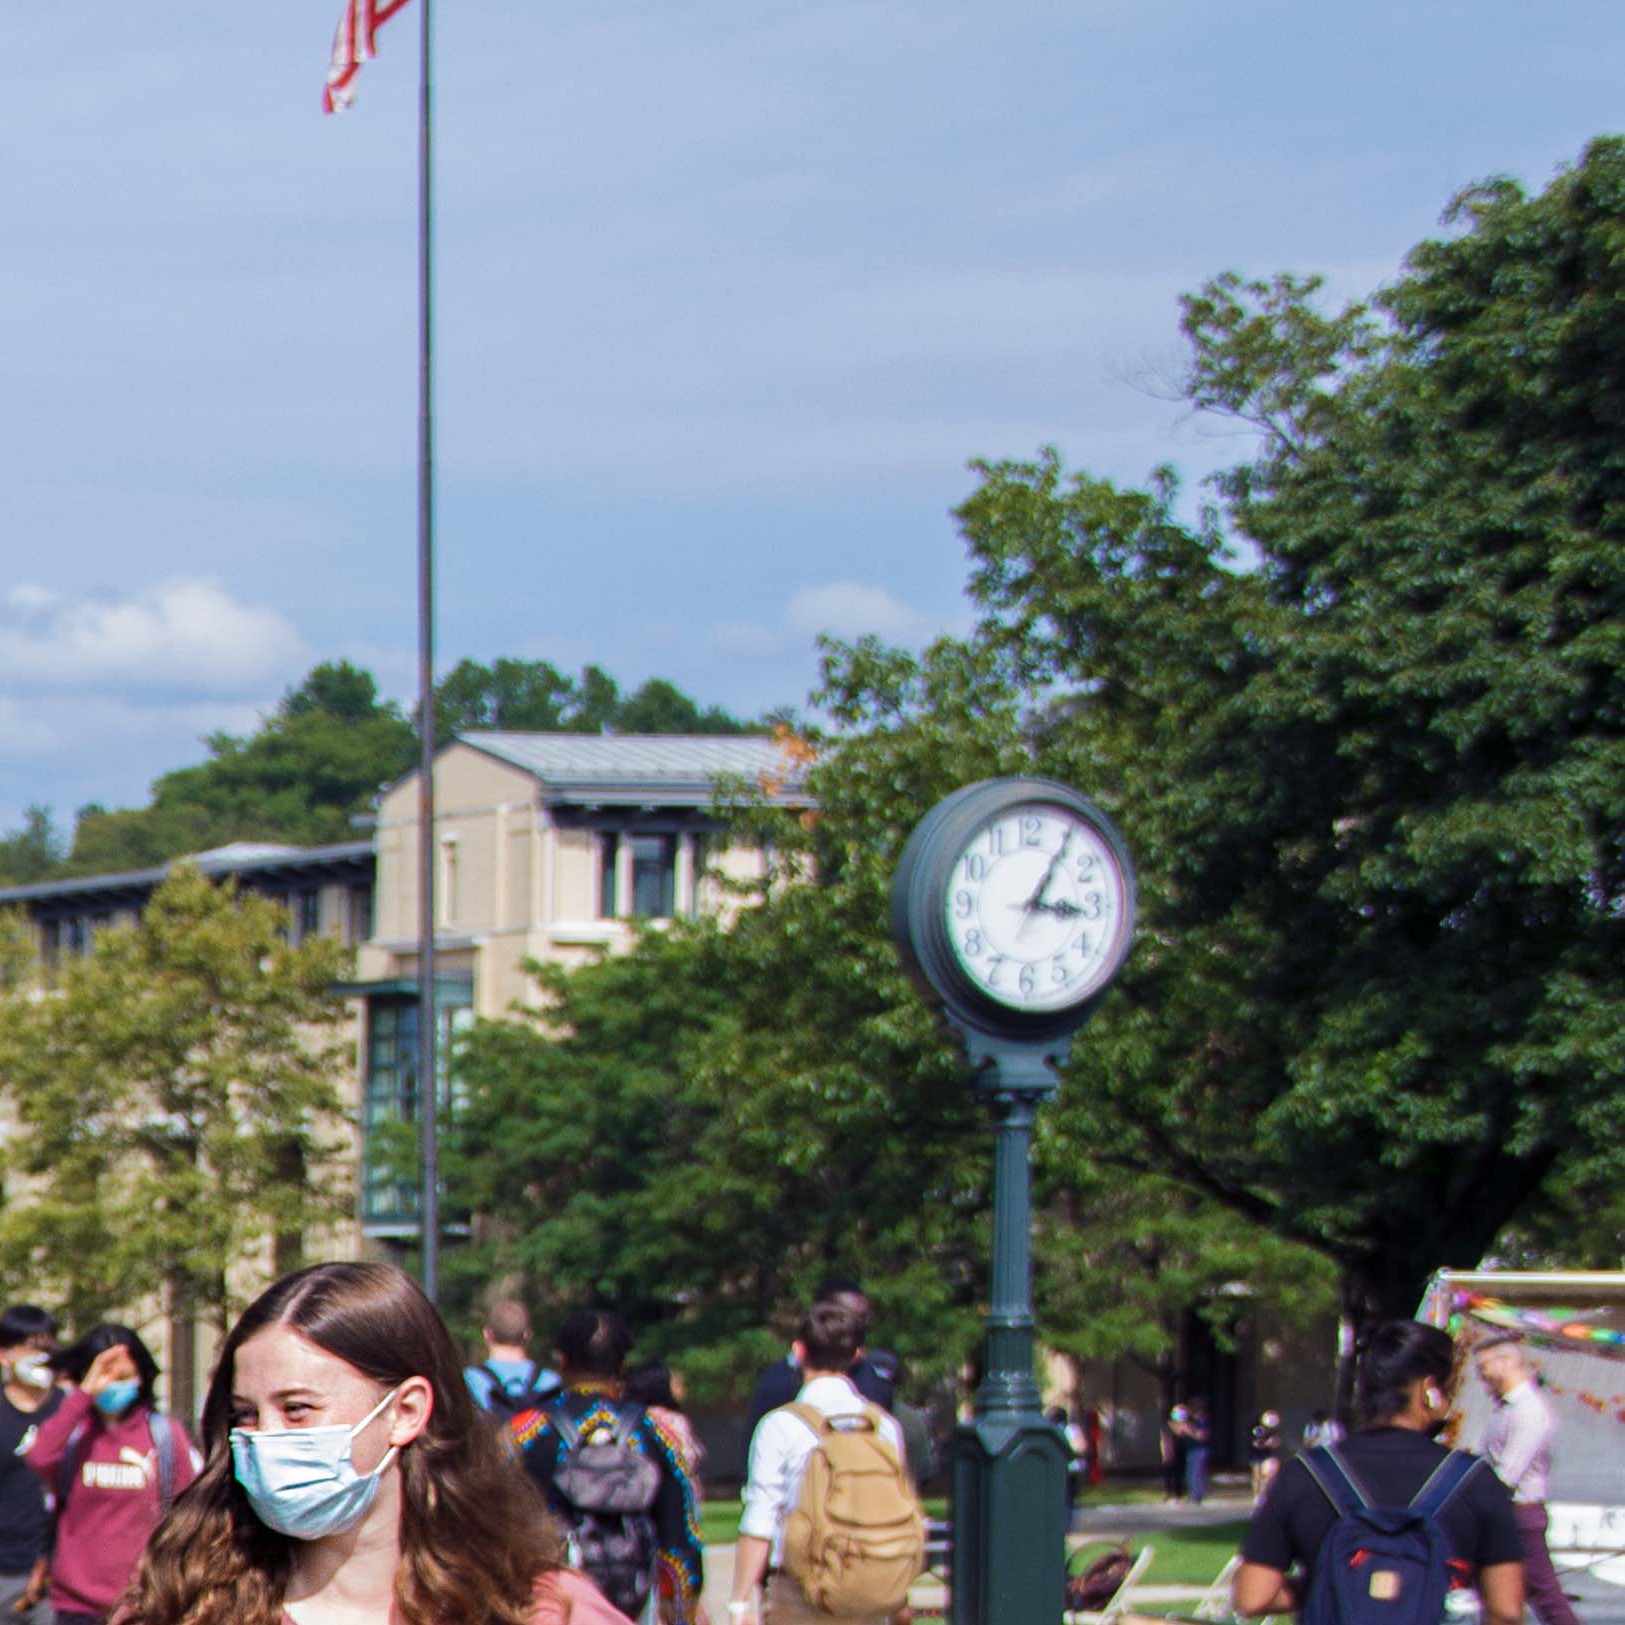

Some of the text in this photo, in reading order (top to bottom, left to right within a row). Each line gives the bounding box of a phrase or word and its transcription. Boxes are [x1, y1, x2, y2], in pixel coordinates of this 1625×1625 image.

[990, 820, 1004, 857] 11
[1019, 816, 1042, 846] 12
[964, 853, 984, 881] 10
[1077, 855, 1093, 882] 2
[956, 890, 972, 918] 9
[1084, 891, 1100, 919] 3
[965, 928, 980, 956] 8
[1072, 932, 1088, 958] 4
[987, 955, 1003, 985] 7
[1019, 962, 1035, 994] 6
[1052, 954, 1067, 983] 5
